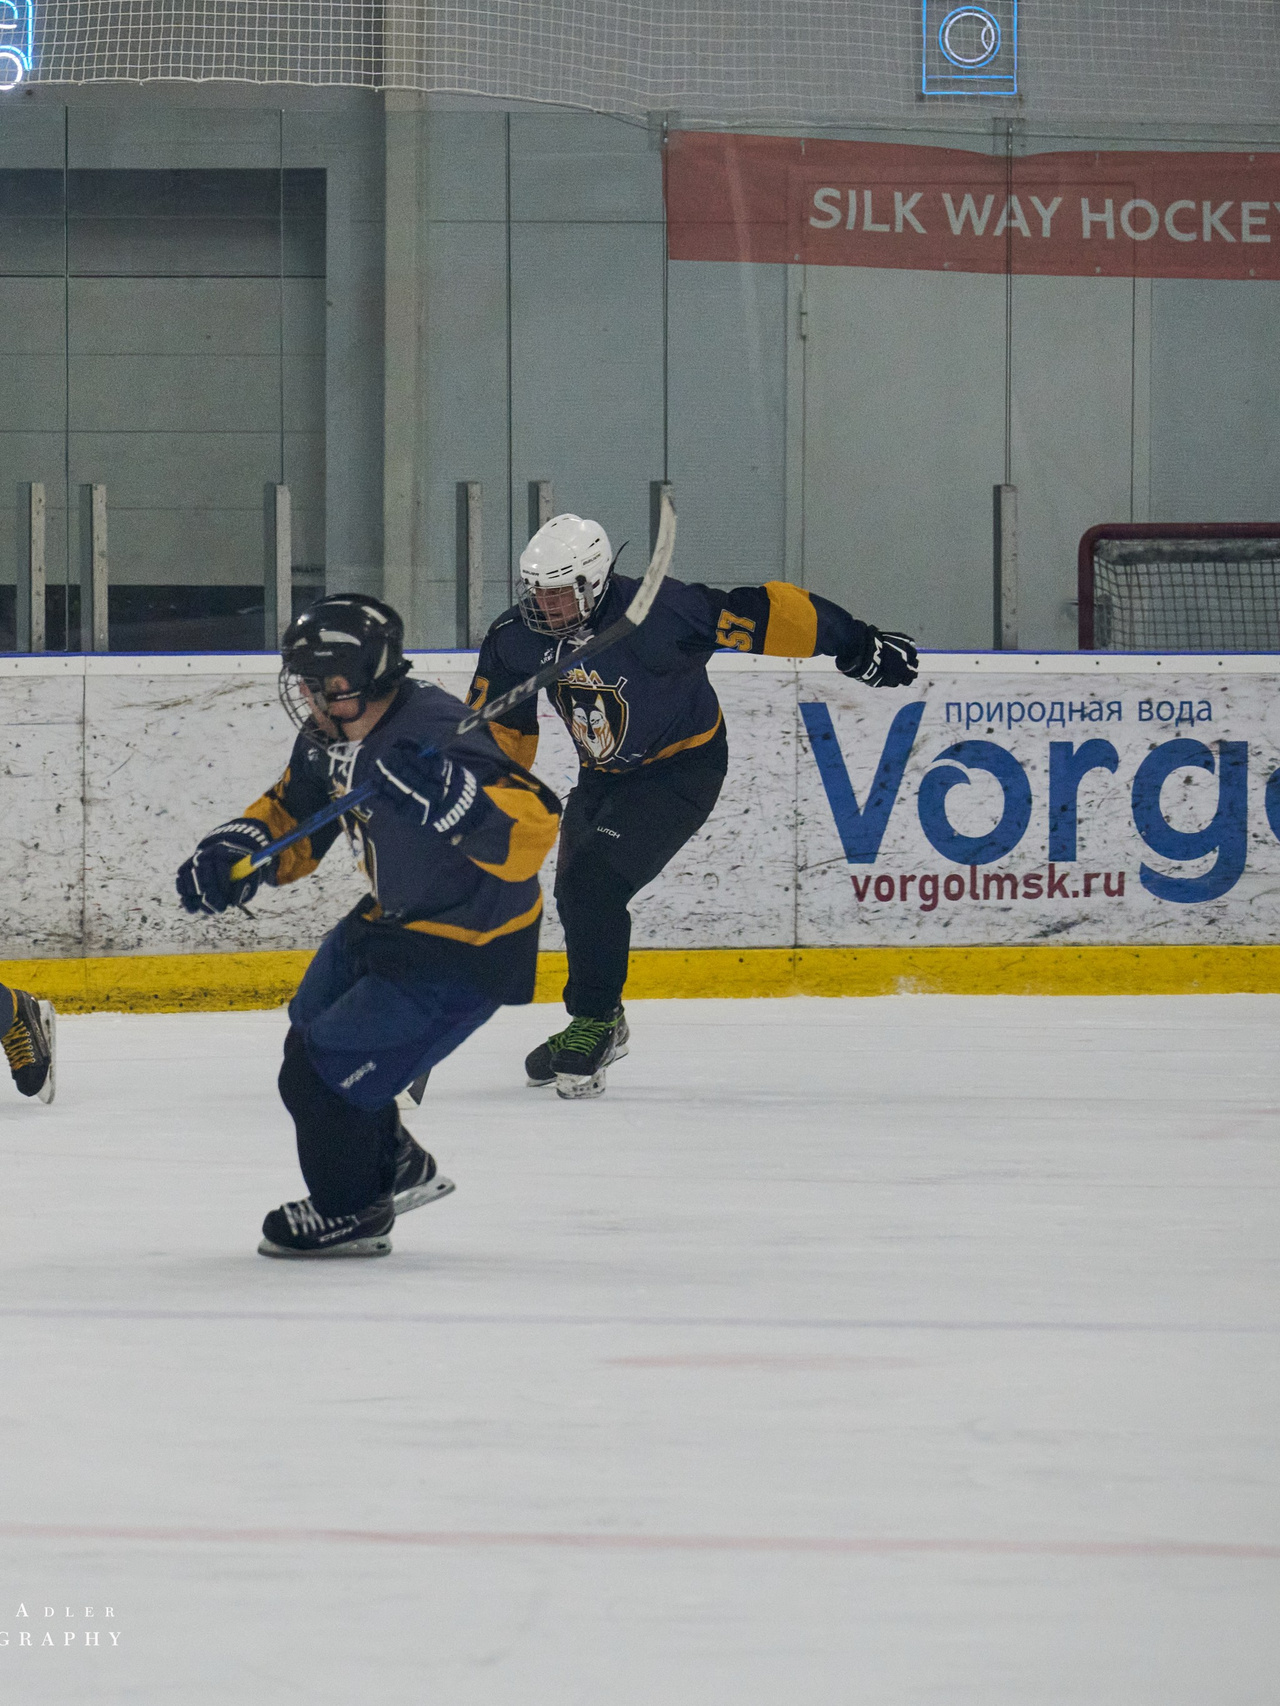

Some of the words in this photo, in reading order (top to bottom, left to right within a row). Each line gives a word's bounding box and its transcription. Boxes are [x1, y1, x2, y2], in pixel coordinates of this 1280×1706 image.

[809, 187, 927, 235] SILK
[941, 192, 1063, 238] WAY
[715, 608, 756, 652] 57
[456, 674, 538, 735] CCM
[945, 700, 1122, 731] природная
[1138, 700, 1213, 728] вода
[799, 700, 1280, 904] Vorg
[850, 863, 1126, 912] vorgolmsk.ru
